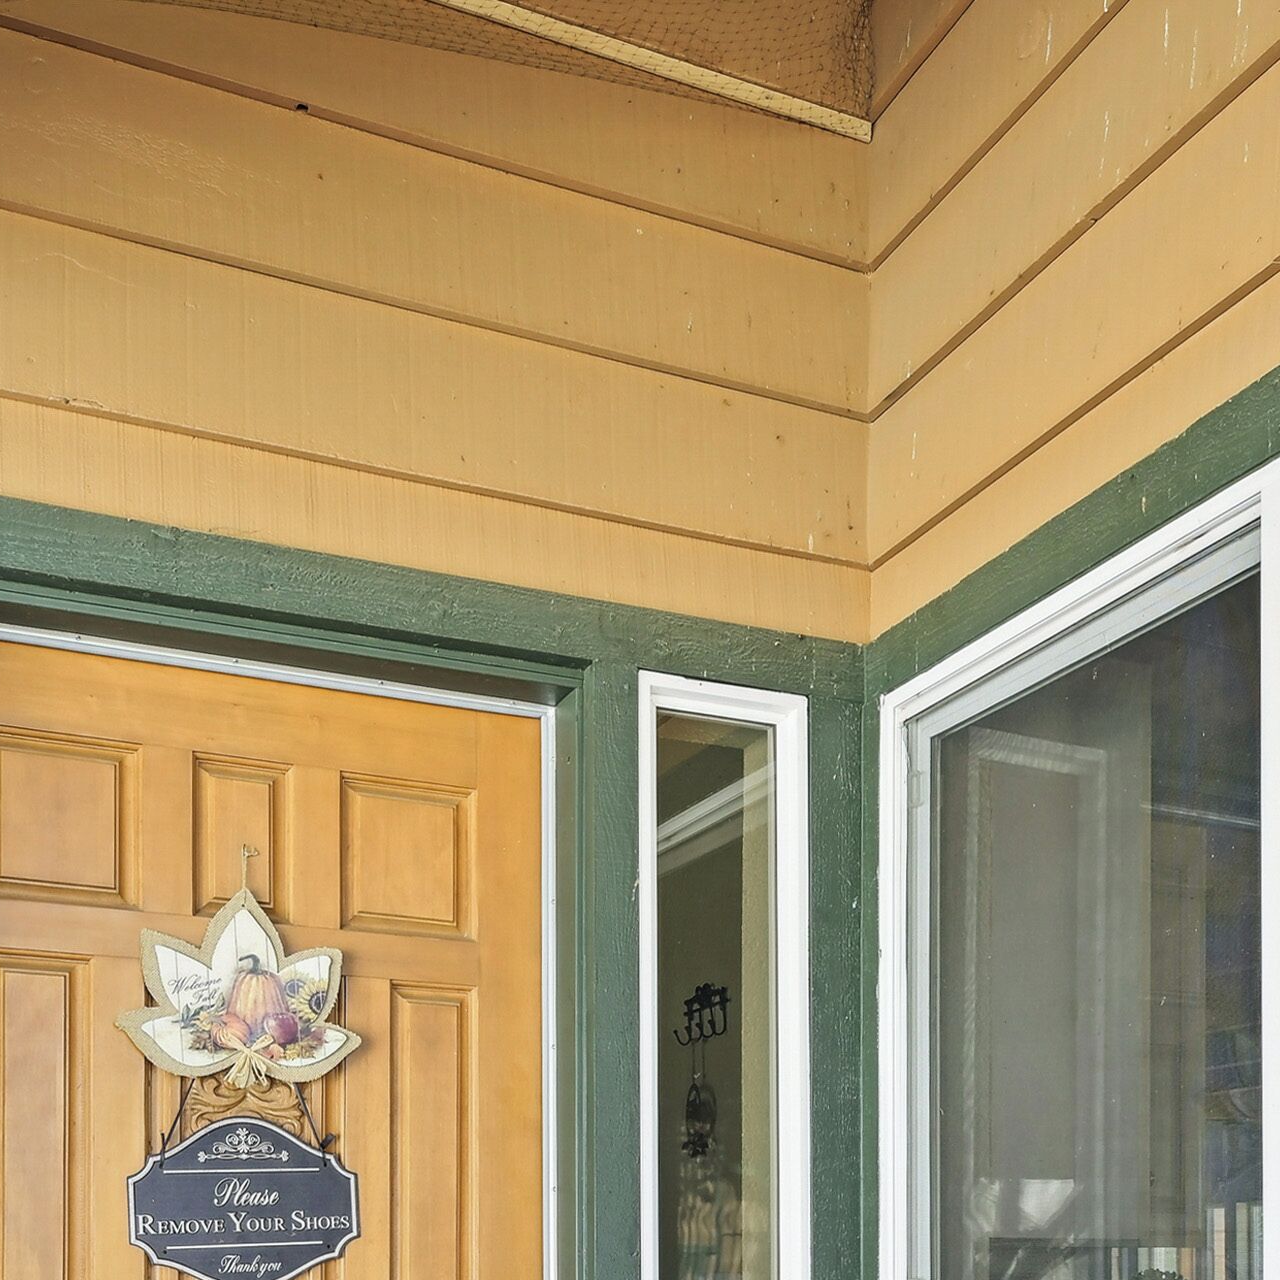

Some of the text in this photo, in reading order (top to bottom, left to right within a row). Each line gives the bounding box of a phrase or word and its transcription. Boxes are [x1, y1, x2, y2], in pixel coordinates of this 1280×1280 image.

[168, 974, 222, 995] Welcome
[188, 988, 218, 1006] Fall
[213, 1177, 280, 1207] Please
[218, 1254, 282, 1278] Thank you
